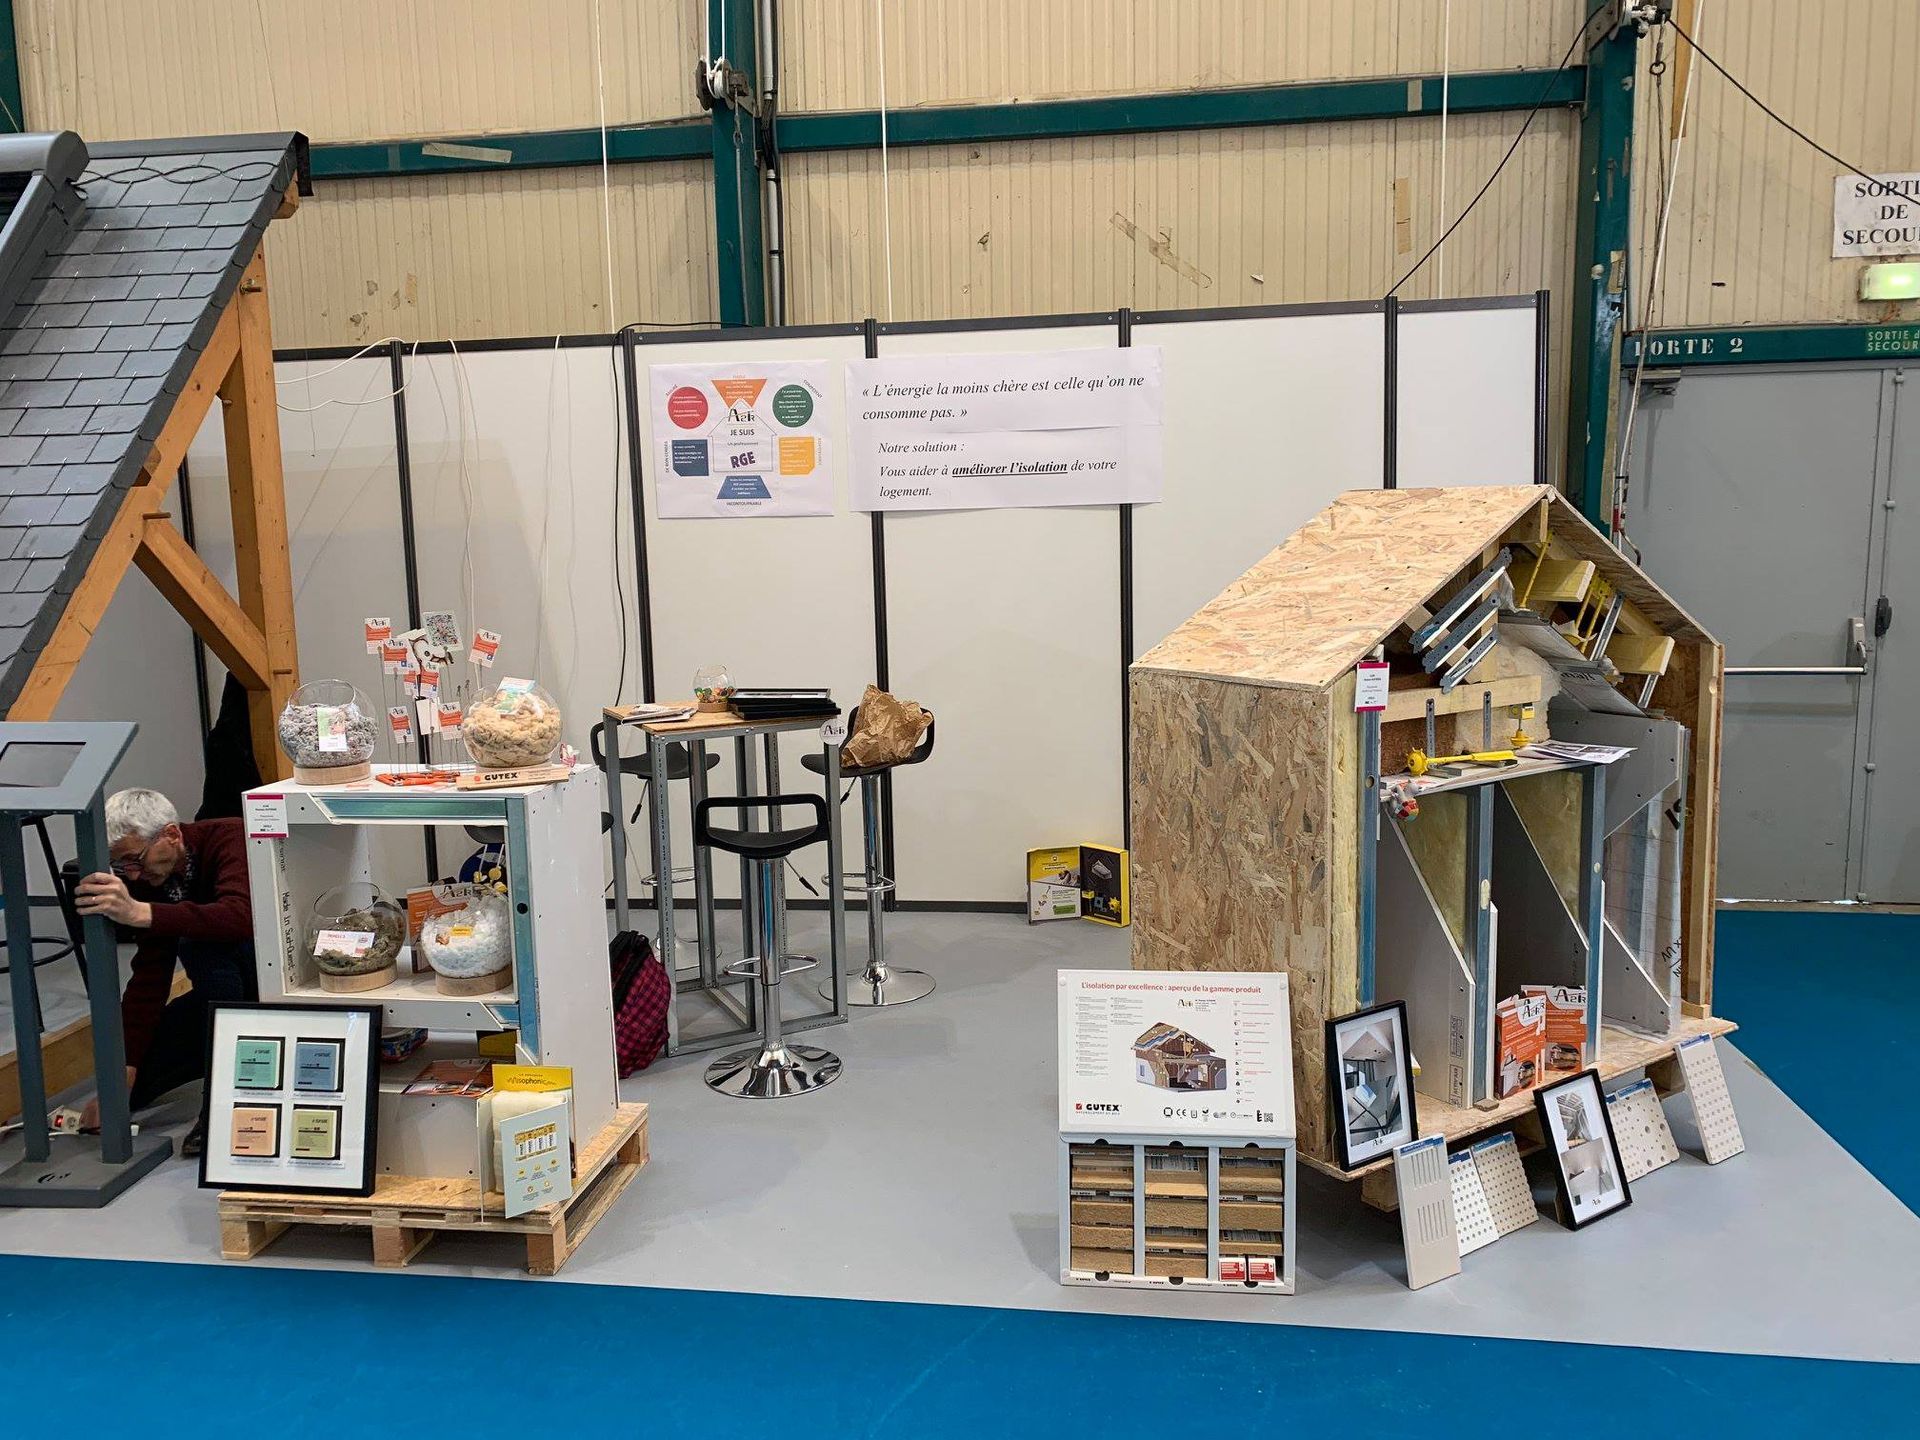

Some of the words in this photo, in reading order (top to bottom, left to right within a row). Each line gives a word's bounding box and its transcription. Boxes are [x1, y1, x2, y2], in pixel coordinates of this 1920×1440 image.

[1881, 204, 1908, 220] DE
[1843, 226, 1920, 245] SECOU
[1868, 330, 1908, 340] SORTIE
[1730, 337, 1743, 353] 2
[1868, 341, 1918, 351] SECOUR
[872, 382, 933, 398] L’énergie
[936, 382, 949, 395] la
[952, 382, 989, 394] moins
[993, 379, 1028, 392] chère
[1032, 380, 1050, 391] est
[1054, 376, 1085, 390] celle
[1087, 376, 1125, 392] qu’on
[1128, 376, 1144, 387] ne
[862, 409, 927, 420] consomme
[930, 408, 956, 422] pas.
[878, 442, 910, 454] Notre
[912, 441, 957, 453] solution
[730, 451, 756, 468] RGE
[879, 466, 907, 477] Vous
[909, 465, 939, 476] aider
[941, 464, 949, 476] à
[951, 463, 1007, 476] améliorer
[1009, 461, 1068, 474] l’isolation
[1070, 461, 1085, 472] de
[1088, 460, 1117, 470] votre
[879, 486, 932, 499] logement.
[485, 772, 518, 780] GUTEX
